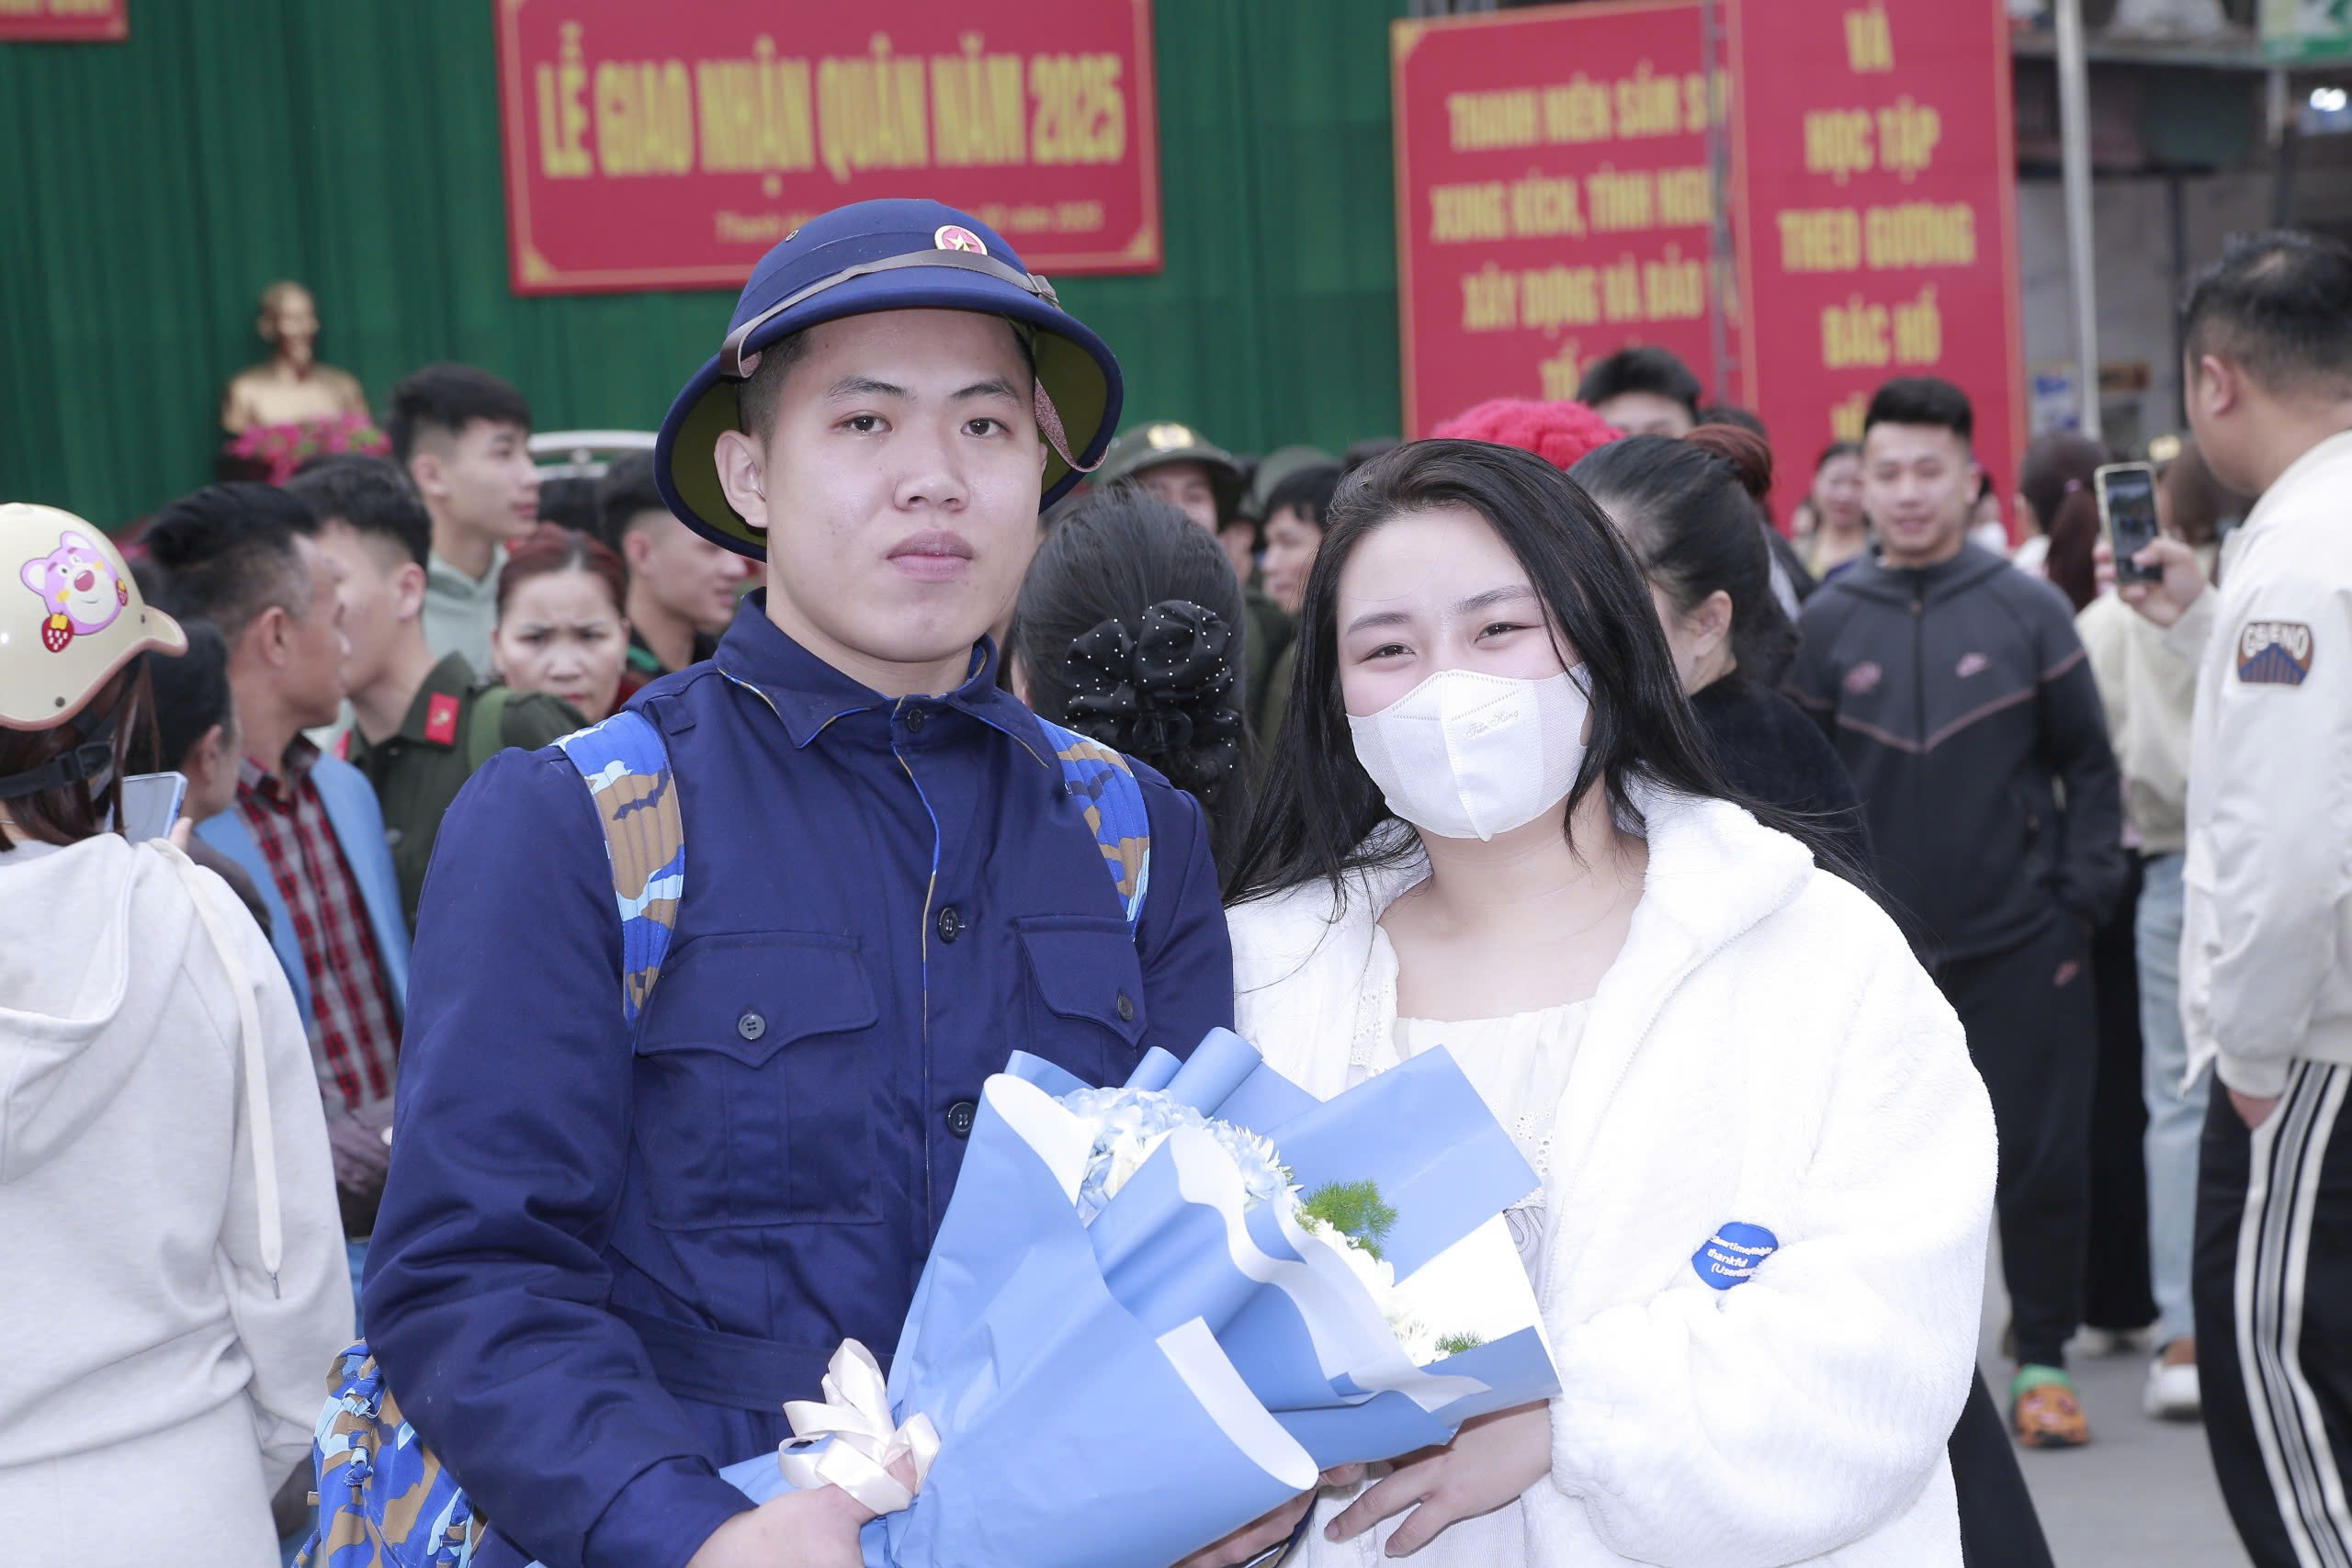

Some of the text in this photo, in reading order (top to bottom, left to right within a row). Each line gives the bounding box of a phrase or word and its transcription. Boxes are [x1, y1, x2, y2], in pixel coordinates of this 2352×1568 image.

[537, 22, 1124, 197] LỄ GIAO NHẬN QUÂN NĂM 2025
[1804, 108, 1874, 186] HỌC
[1779, 209, 1859, 271] THEO
[1822, 293, 1889, 368] BÁC
